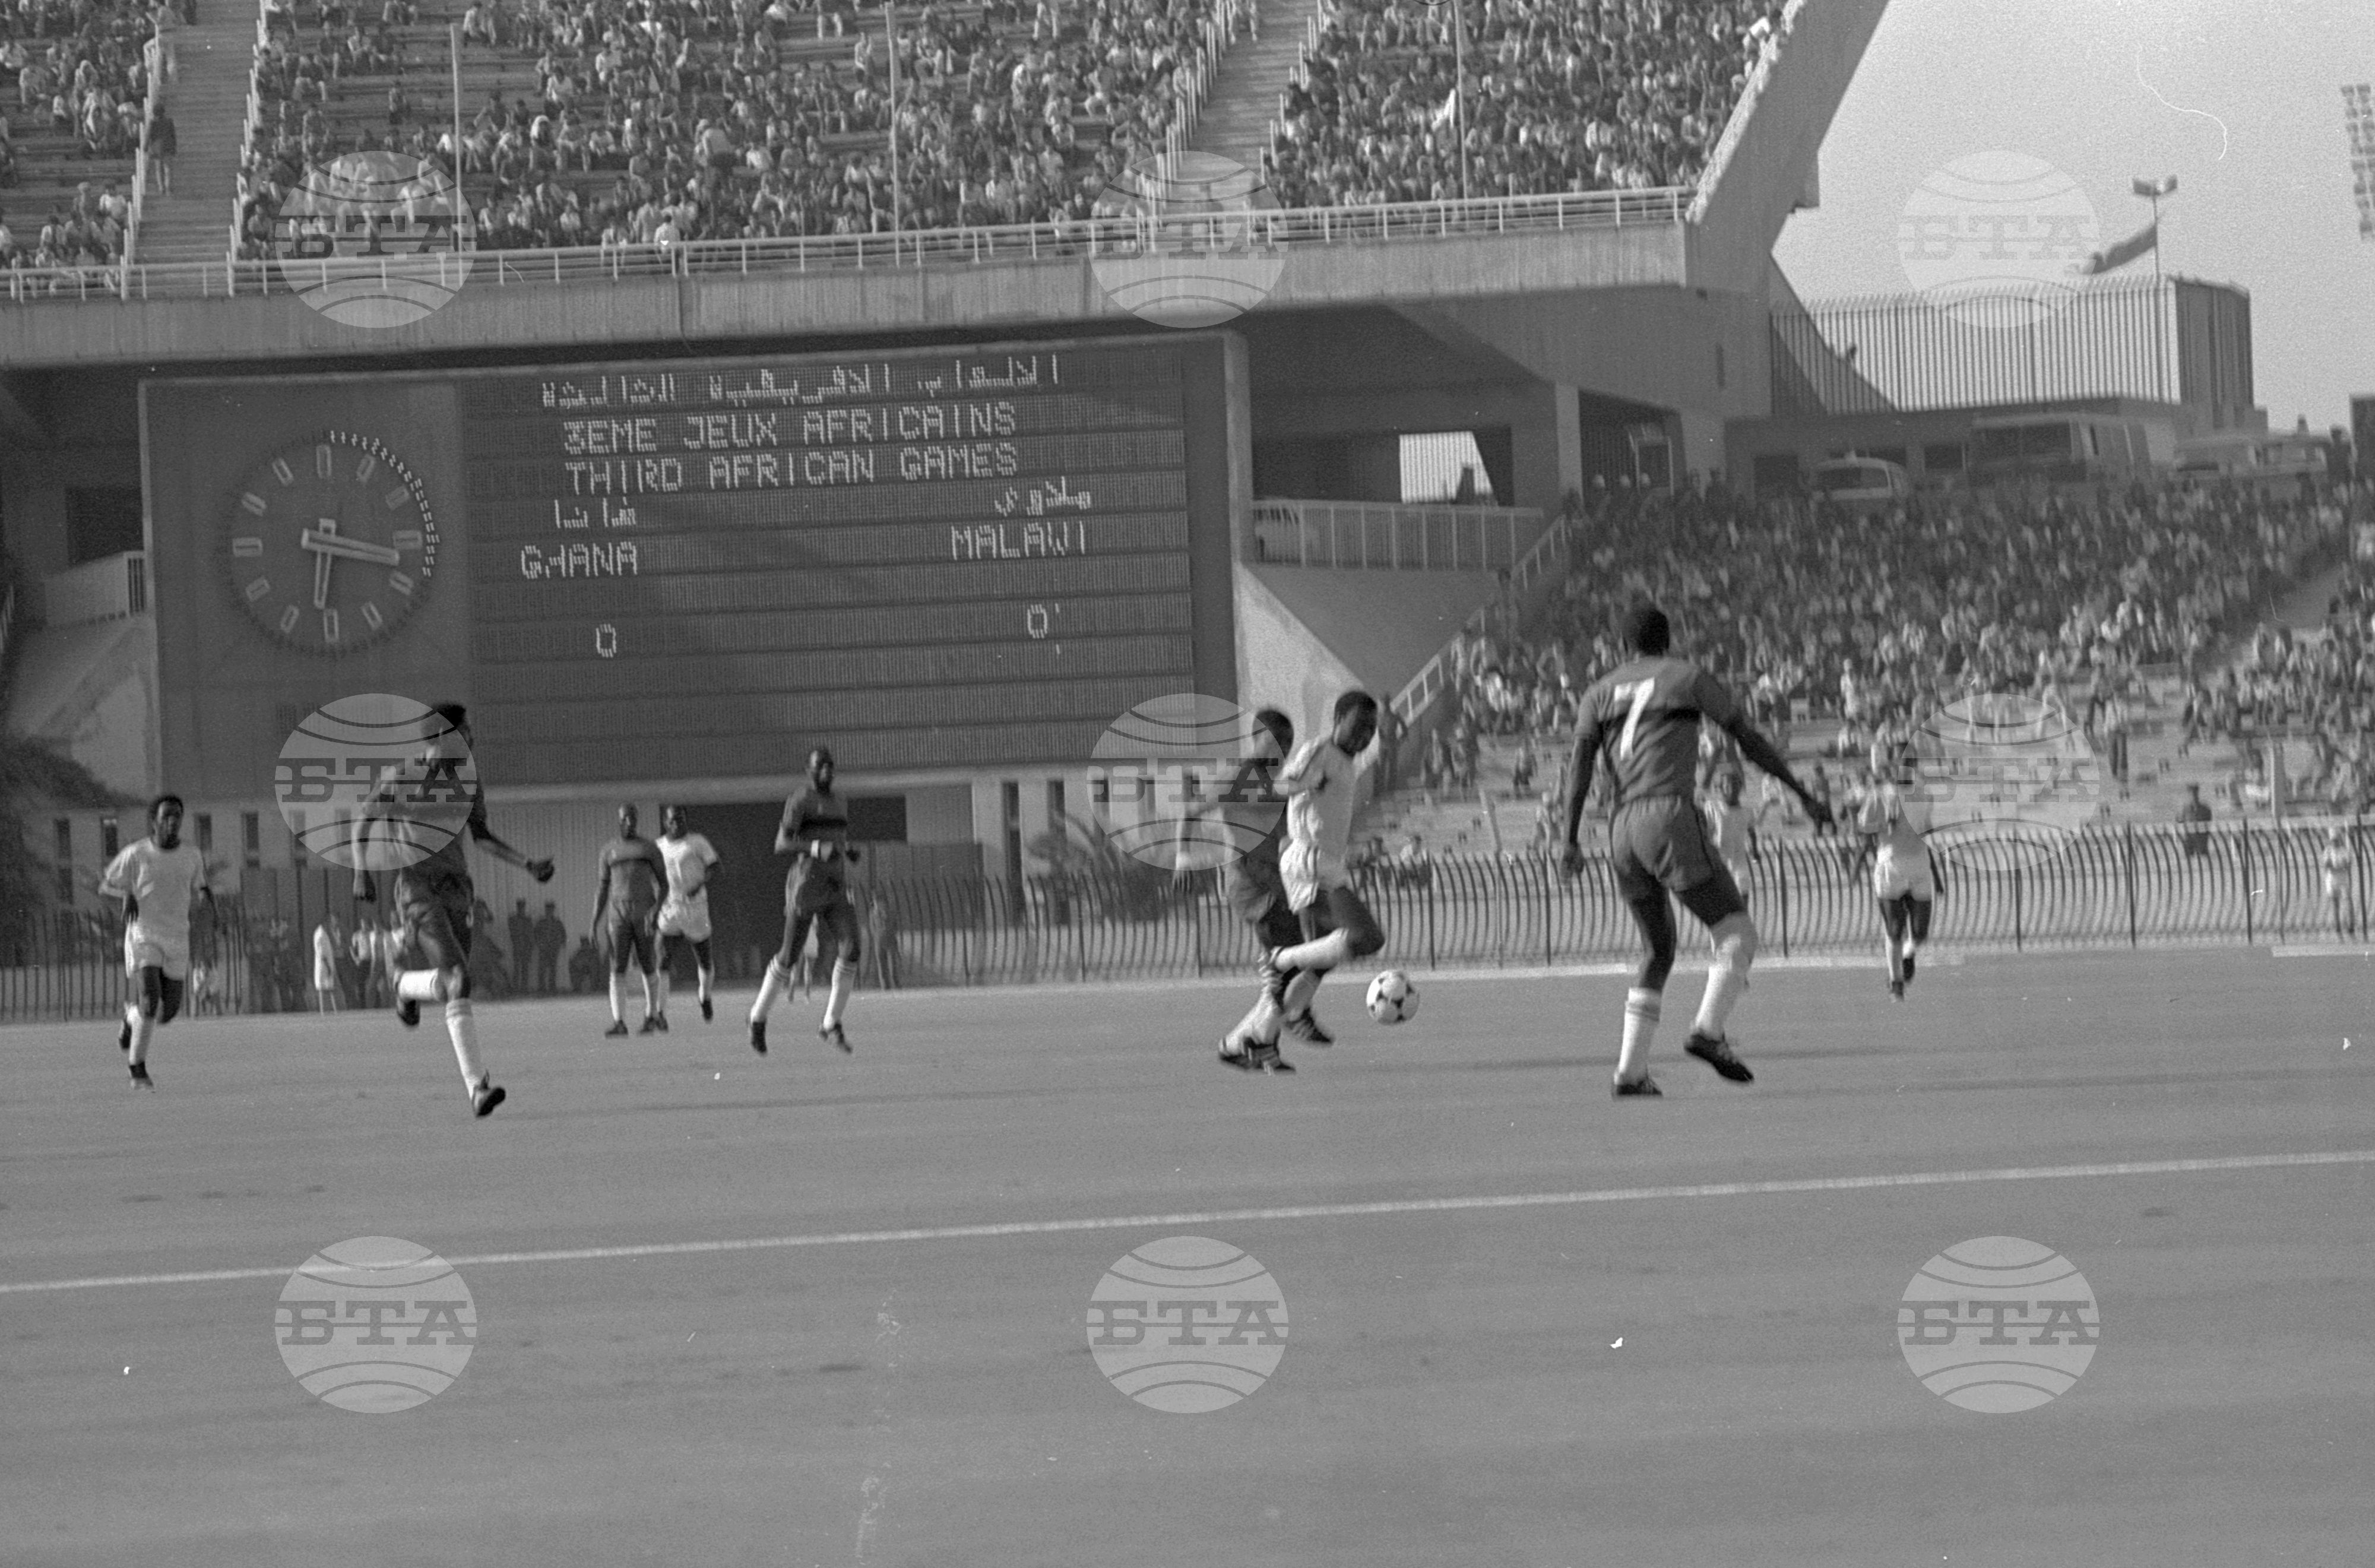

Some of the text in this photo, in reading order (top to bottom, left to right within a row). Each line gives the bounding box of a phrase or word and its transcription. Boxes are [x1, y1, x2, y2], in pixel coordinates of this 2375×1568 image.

[683, 413, 777, 449] JEUX
[805, 401, 1016, 445] AFRICAINS
[565, 442, 1017, 495] THIRD AFRICAN GAMES
[951, 520, 1085, 561] MALAWI
[1614, 677, 1655, 761] 7
